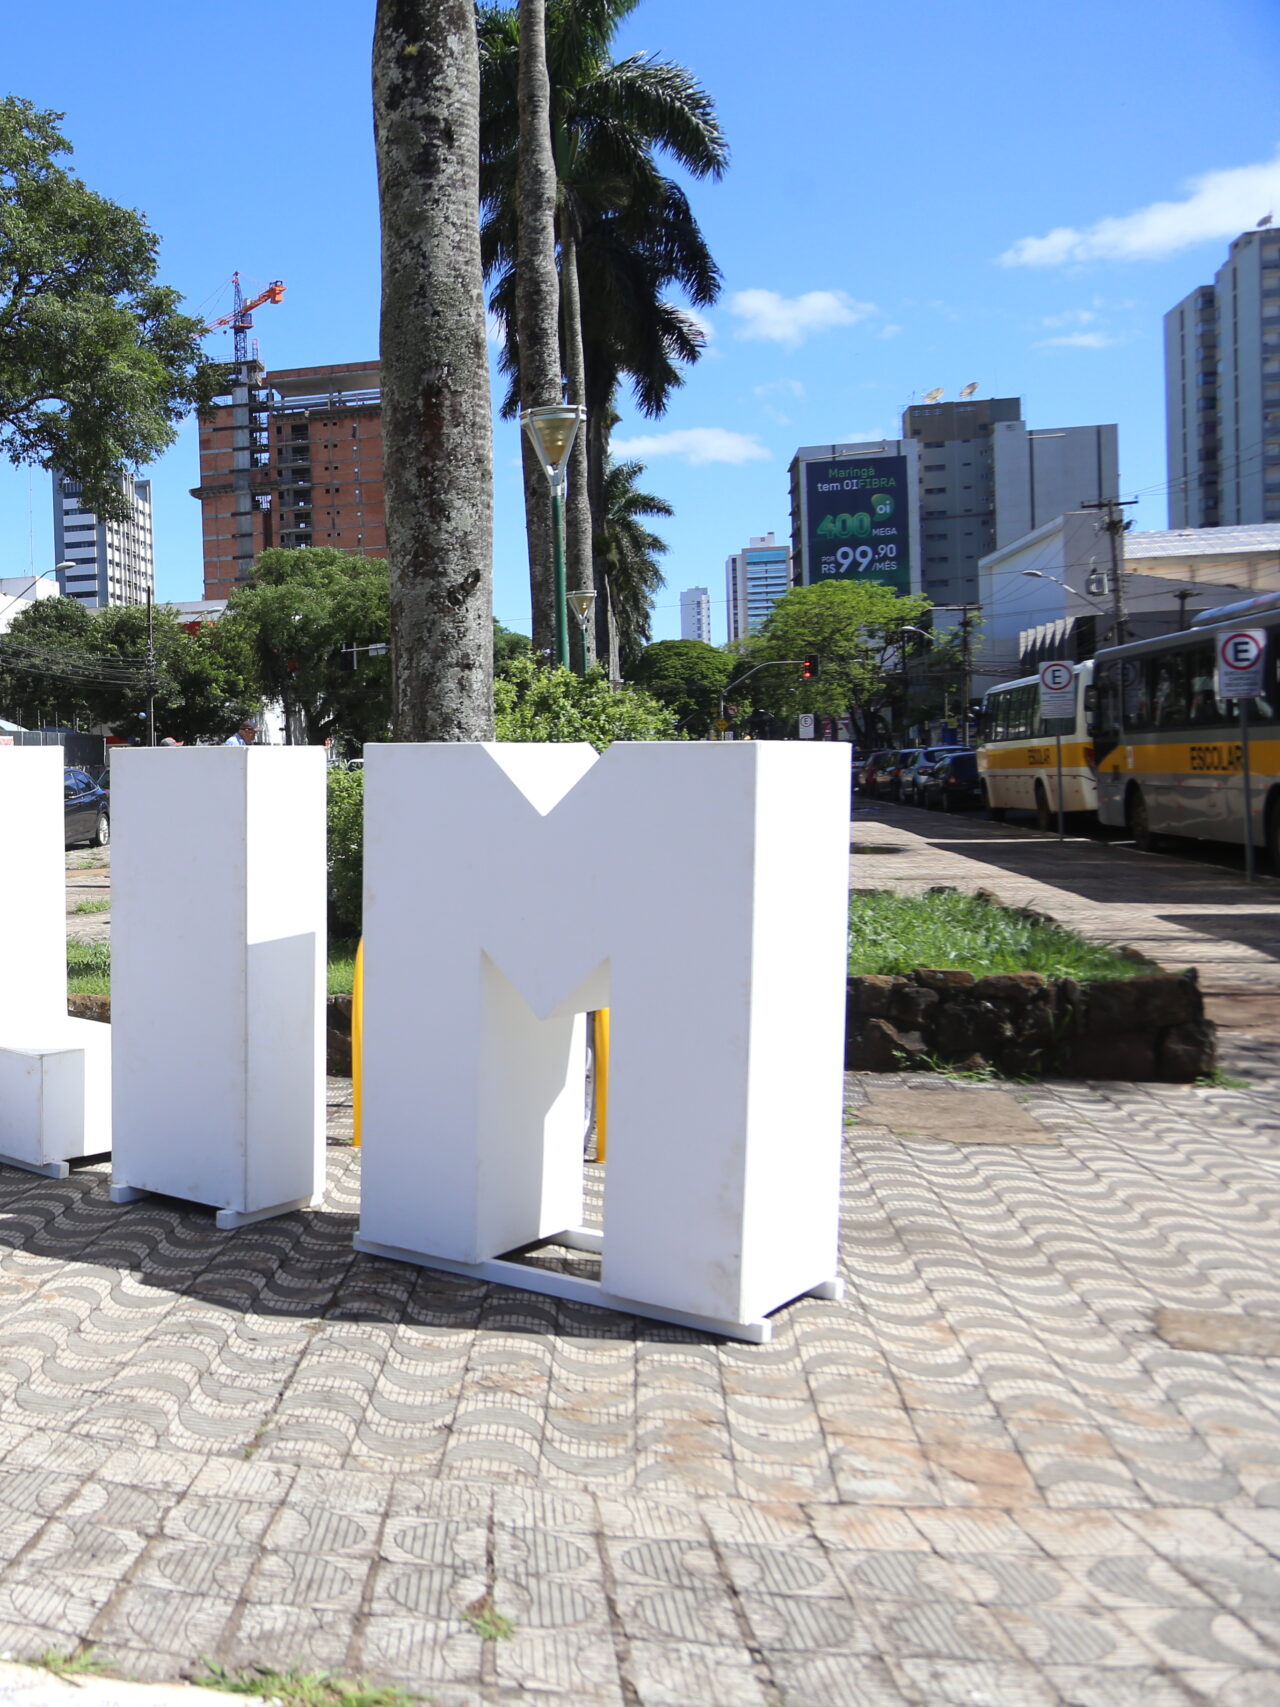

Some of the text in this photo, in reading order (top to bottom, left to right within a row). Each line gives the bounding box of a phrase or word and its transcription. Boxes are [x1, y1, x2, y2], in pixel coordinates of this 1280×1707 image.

[828, 466, 875, 479] Maringá
[817, 482, 841, 492] tem
[876, 500, 891, 514] oi
[816, 512, 898, 539] 400 MEGA
[1233, 641, 1250, 663] E
[1051, 669, 1062, 685] E
